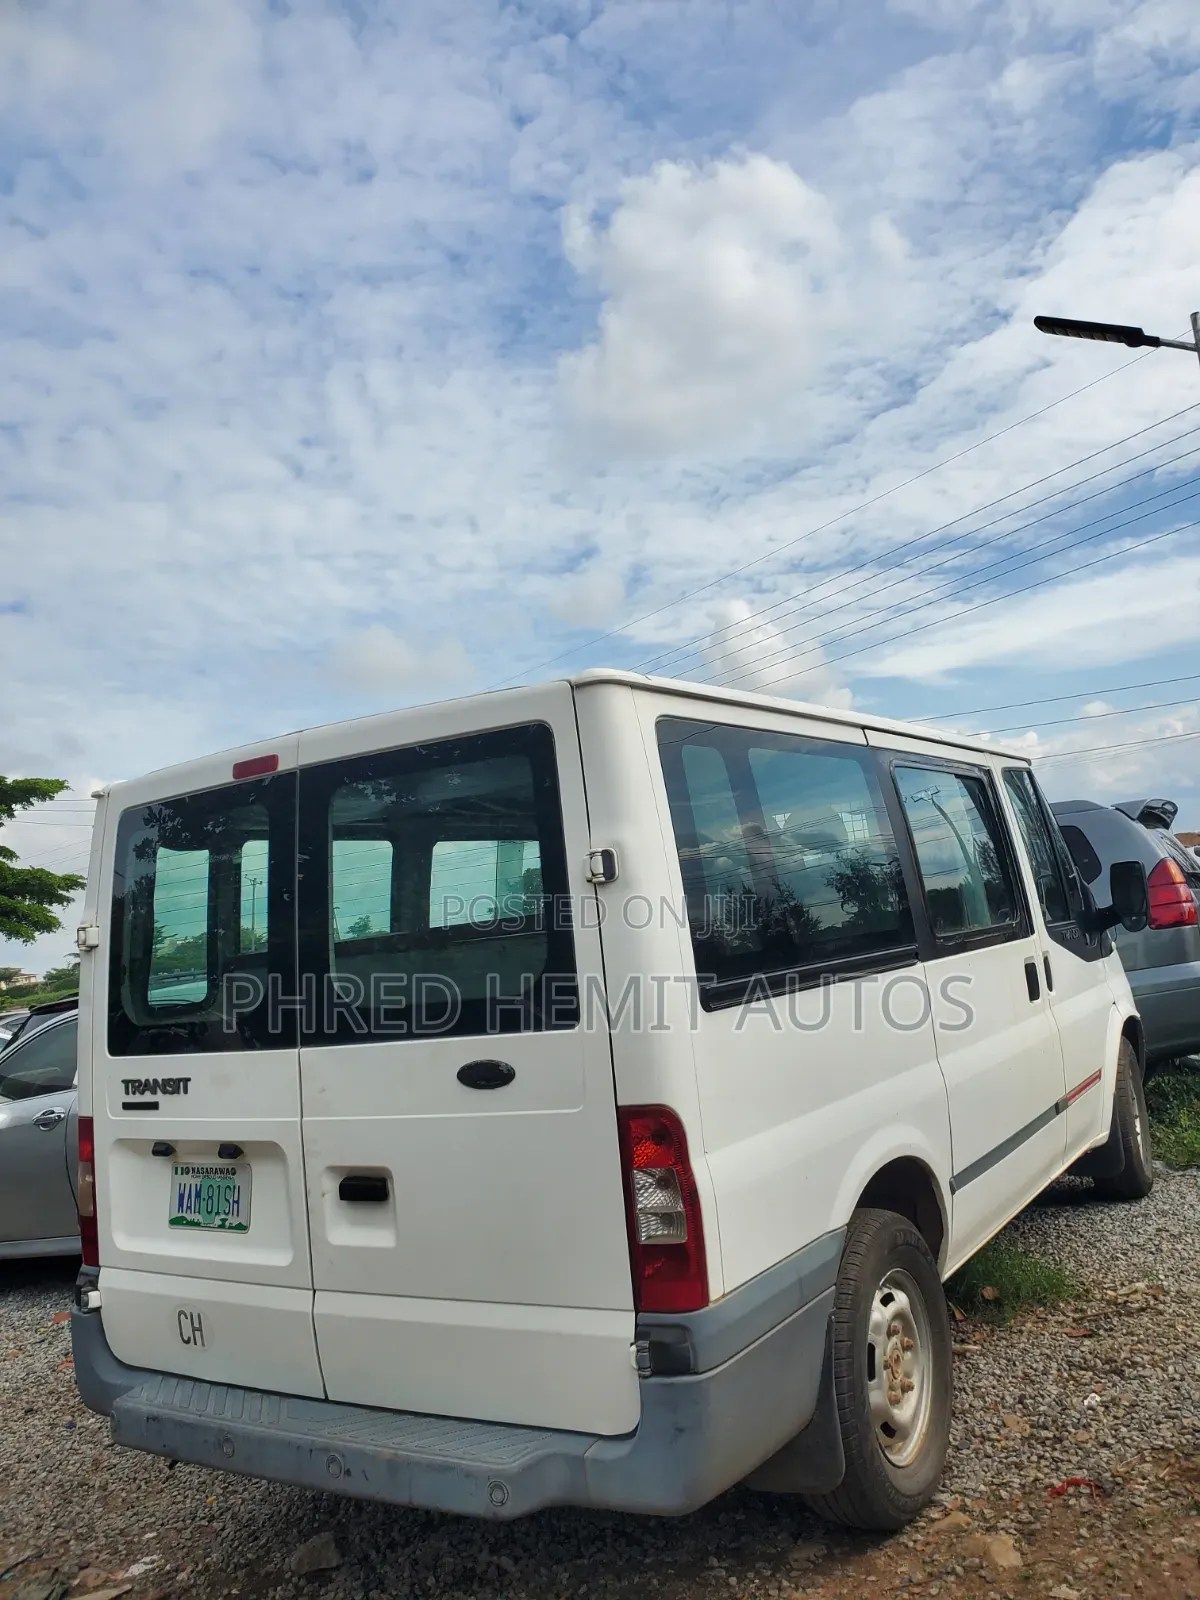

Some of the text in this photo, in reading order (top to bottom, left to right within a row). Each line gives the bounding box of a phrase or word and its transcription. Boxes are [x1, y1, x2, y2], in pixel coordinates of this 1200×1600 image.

[121, 1077, 191, 1096] TRANSIT
[191, 1167, 231, 1175] NASARAWA
[177, 1309, 206, 1348] CH
